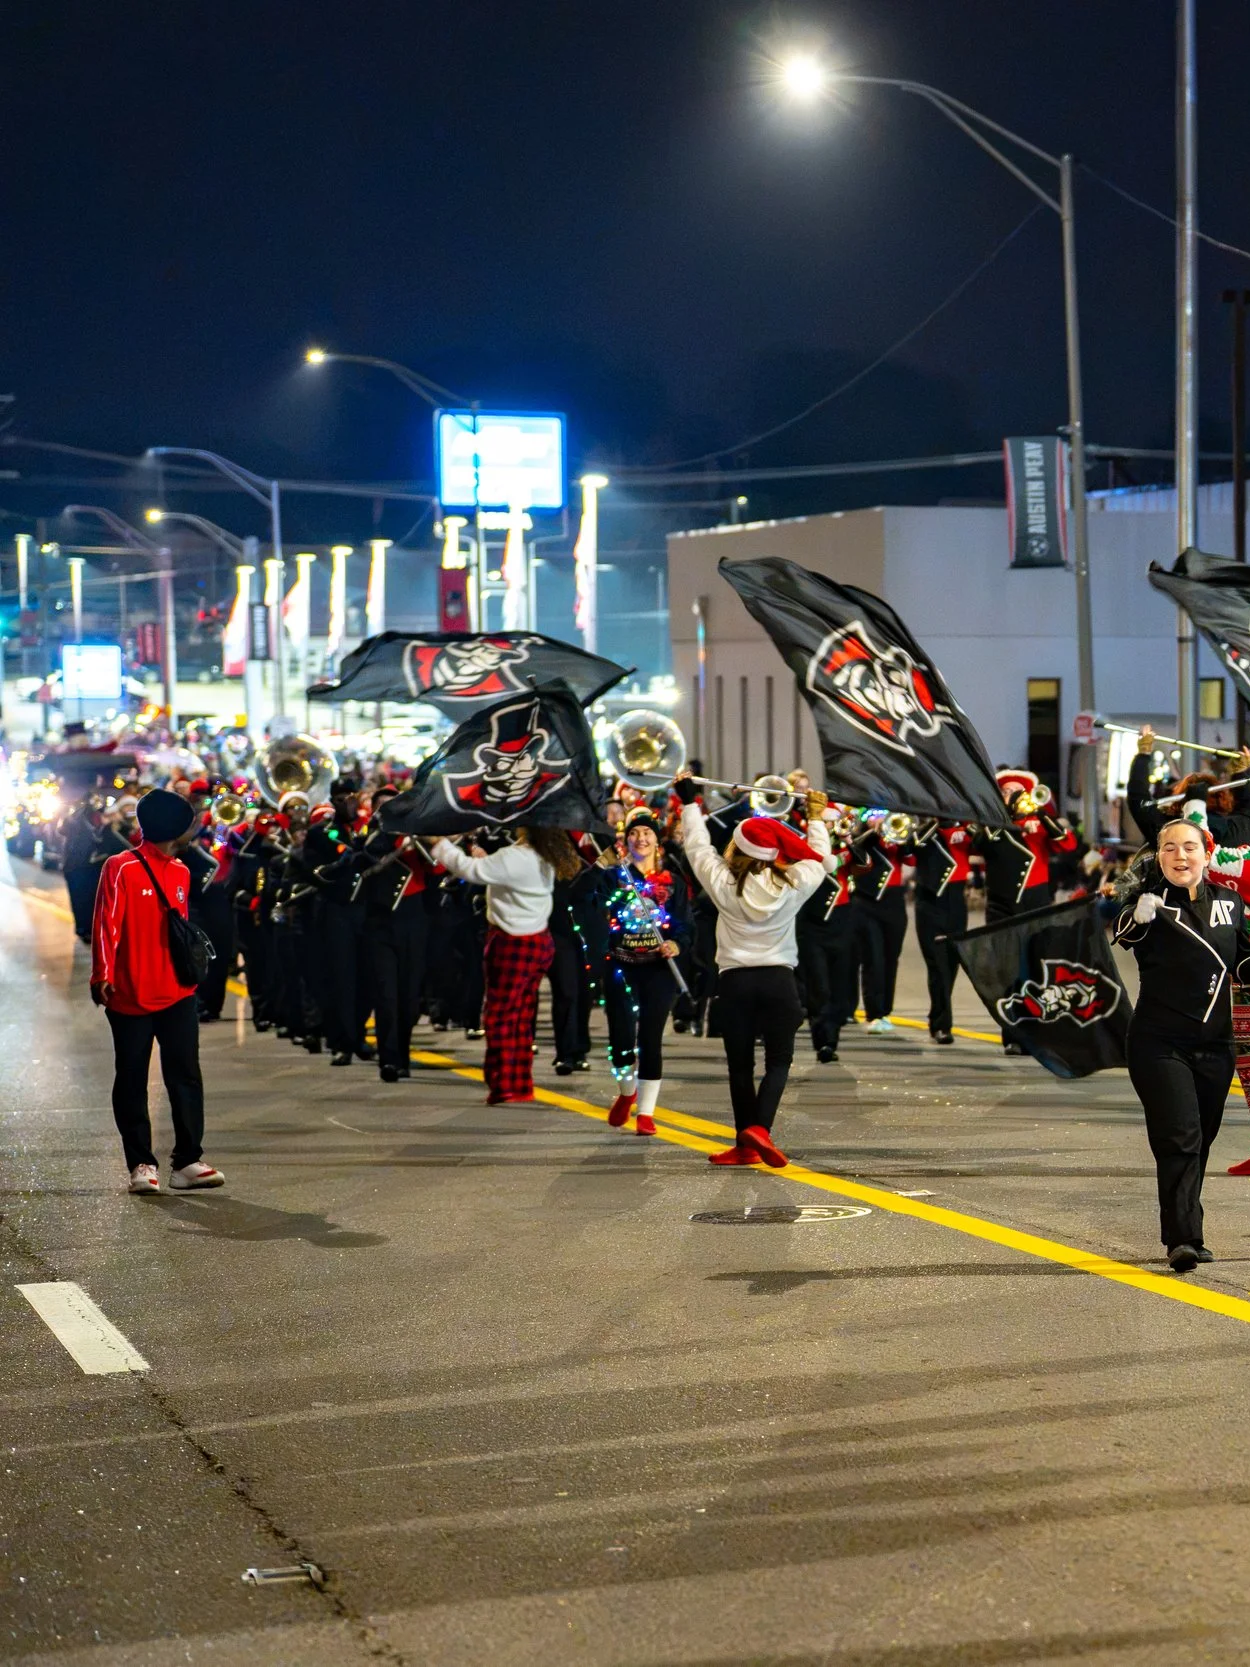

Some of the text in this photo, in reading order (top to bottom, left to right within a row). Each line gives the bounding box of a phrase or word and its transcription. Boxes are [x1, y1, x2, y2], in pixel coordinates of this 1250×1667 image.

[1023, 441, 1047, 534] AUSTIN PEAY
[1209, 899, 1235, 928] AP
